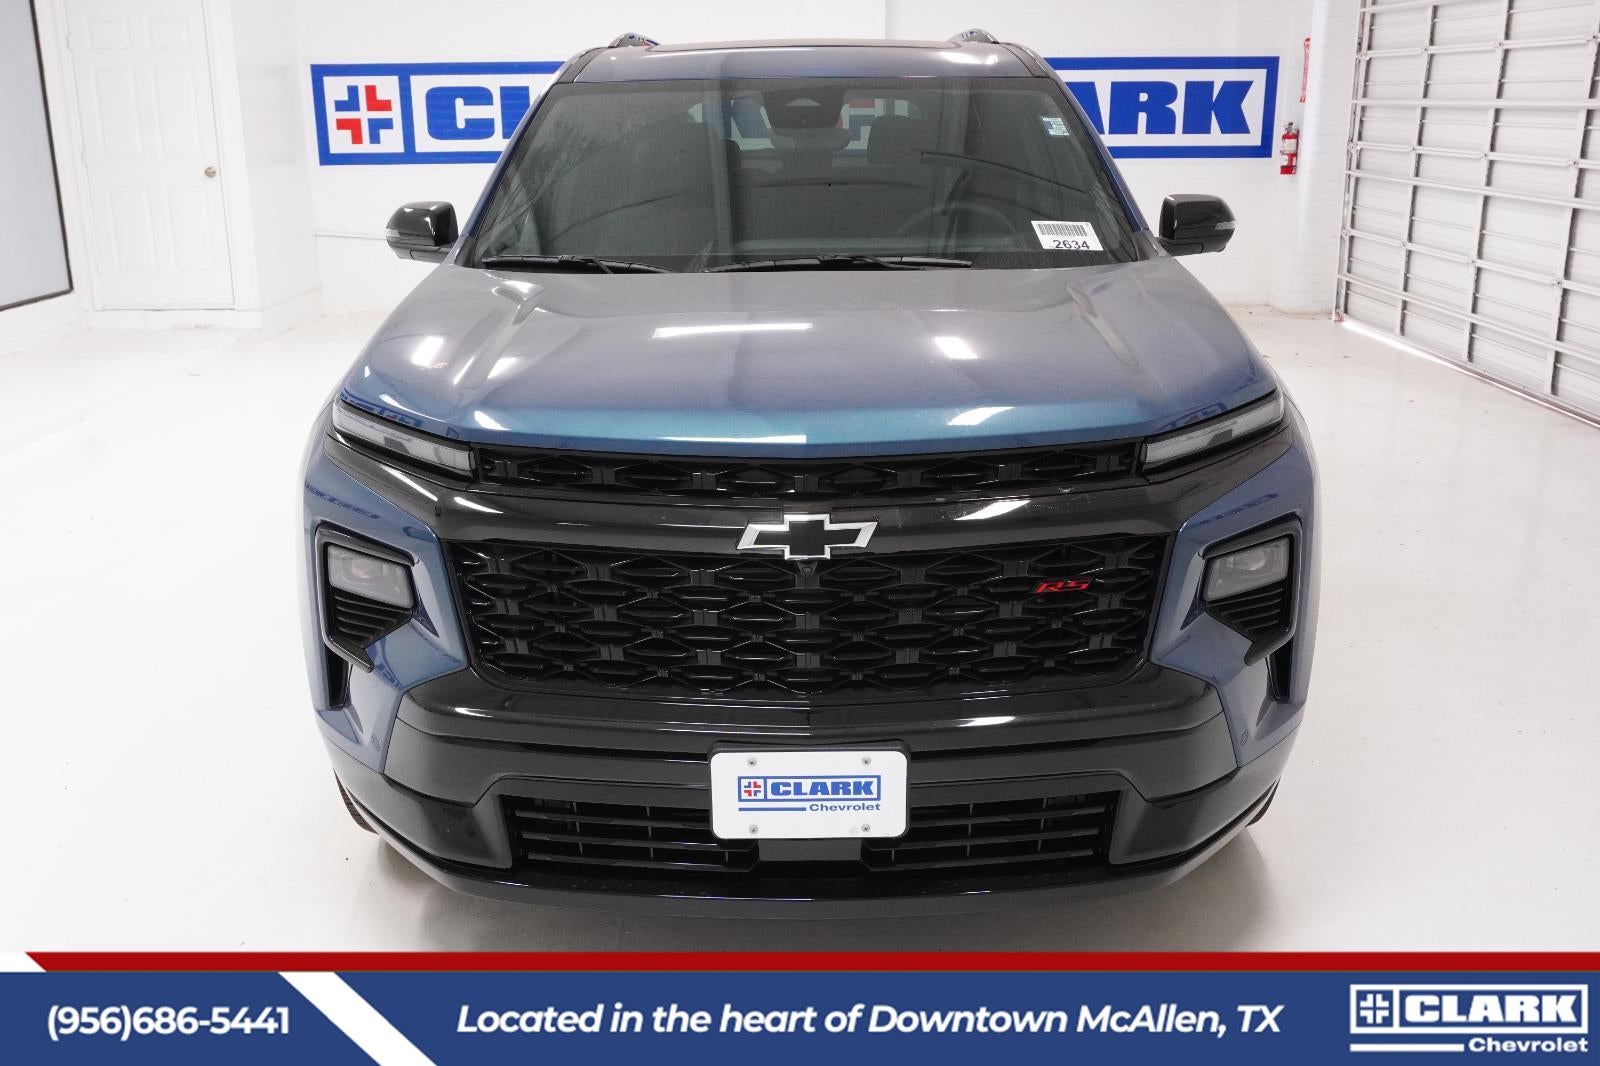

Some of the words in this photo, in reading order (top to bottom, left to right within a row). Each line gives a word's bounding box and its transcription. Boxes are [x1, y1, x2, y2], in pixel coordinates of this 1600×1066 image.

[1052, 239, 1090, 250] 2634
[1035, 579, 1090, 593] RS
[770, 780, 874, 796] CLARK
[809, 803, 881, 812] Chevrolet
